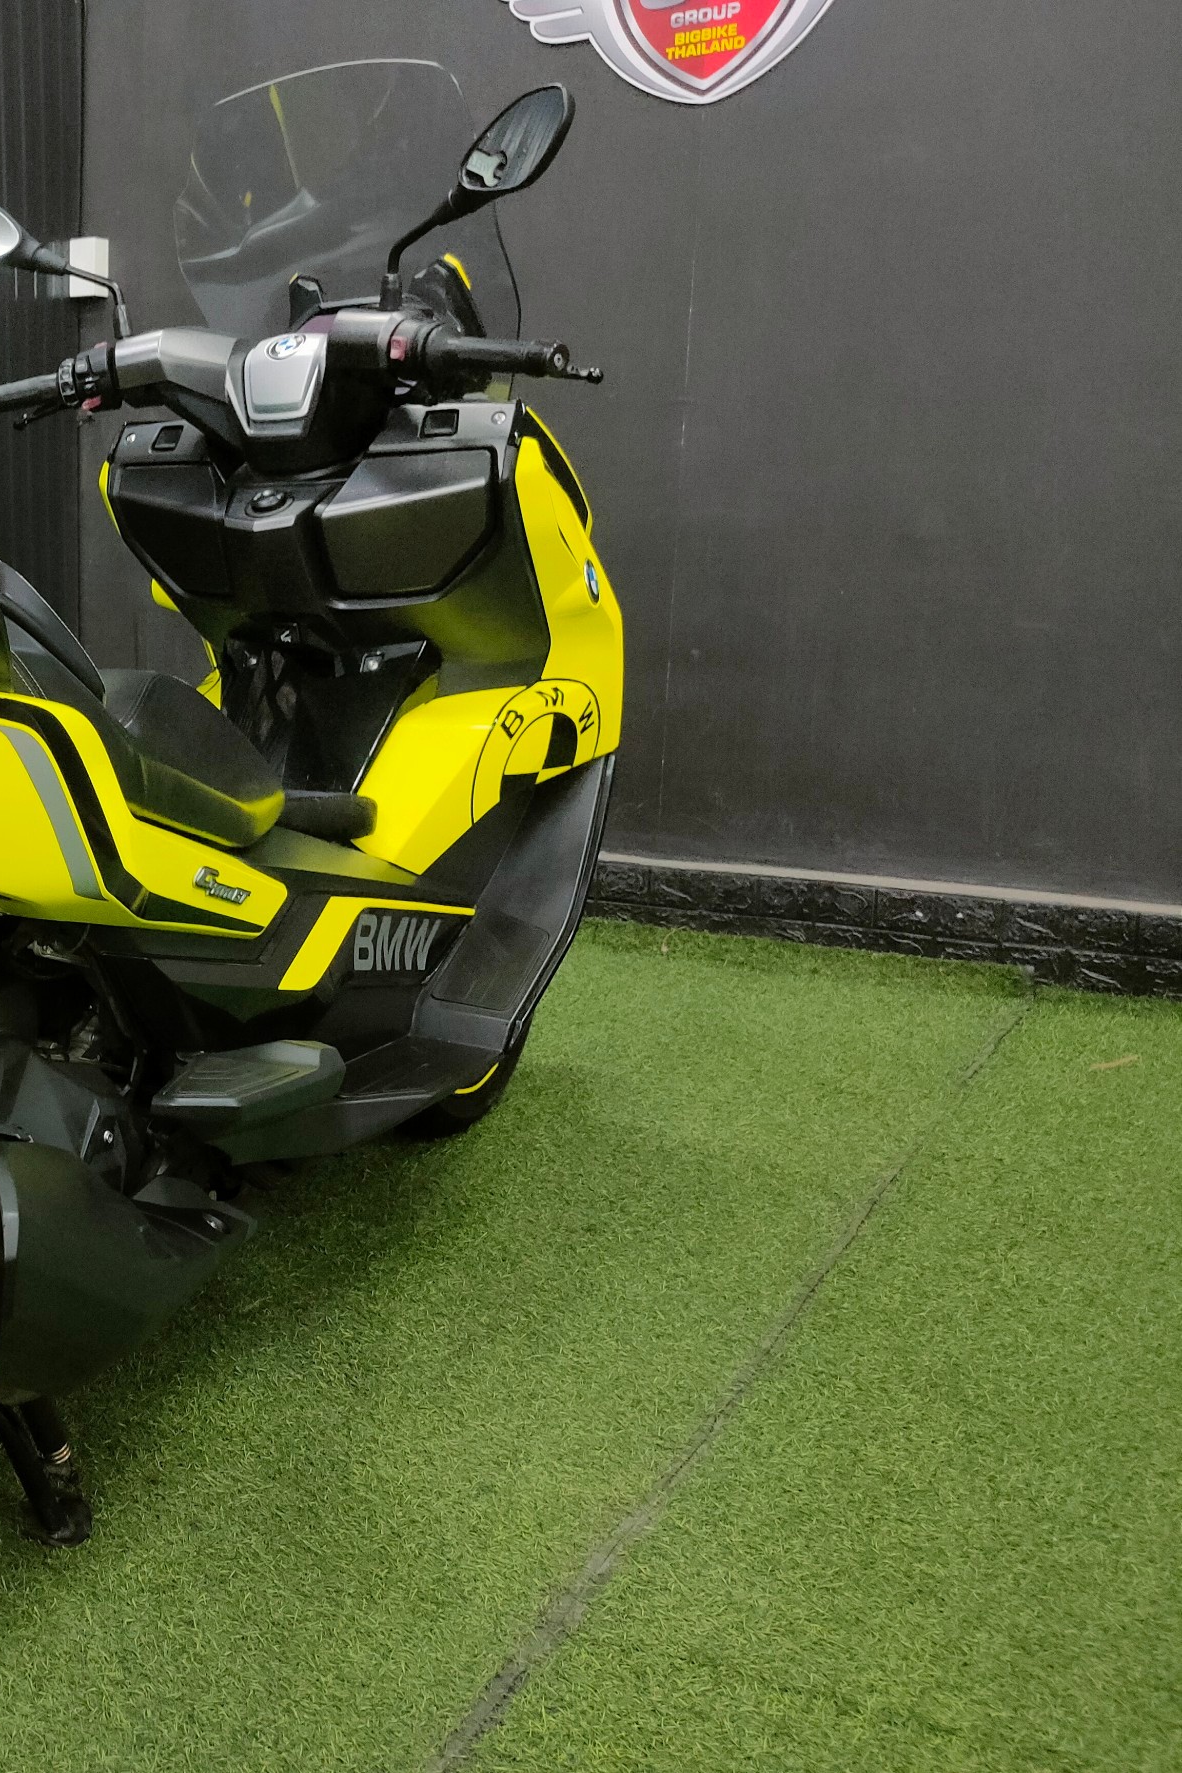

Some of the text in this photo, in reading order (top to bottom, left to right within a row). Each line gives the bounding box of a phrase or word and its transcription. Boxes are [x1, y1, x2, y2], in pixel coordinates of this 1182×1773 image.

[670, 2, 741, 28] GROUP
[665, 35, 746, 60] THAILAND
[674, 23, 738, 46] BIGBIKE
[501, 687, 594, 740] BMW
[353, 913, 442, 972] BMW
